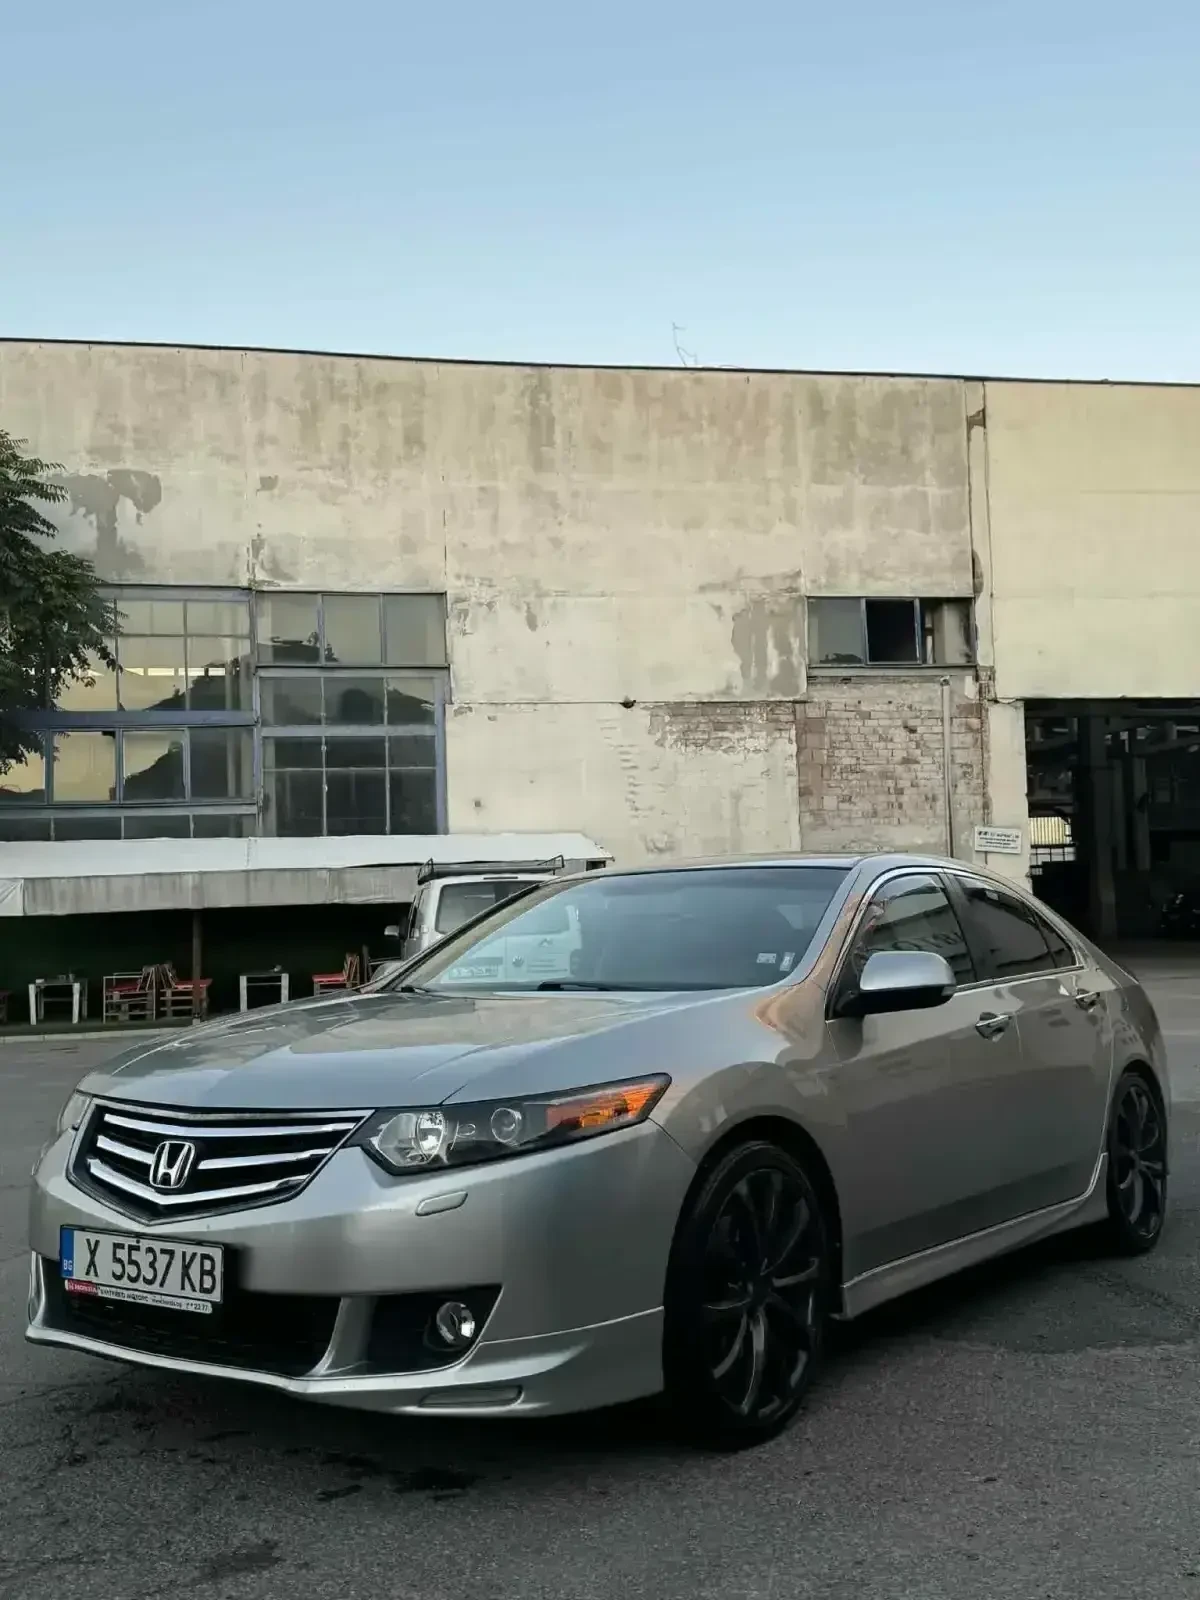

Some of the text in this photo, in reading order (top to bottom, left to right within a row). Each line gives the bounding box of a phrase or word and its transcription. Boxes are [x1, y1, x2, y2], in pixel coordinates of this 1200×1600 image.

[63, 1259, 73, 1271] BG
[85, 1238, 216, 1295] X 5537 KB
